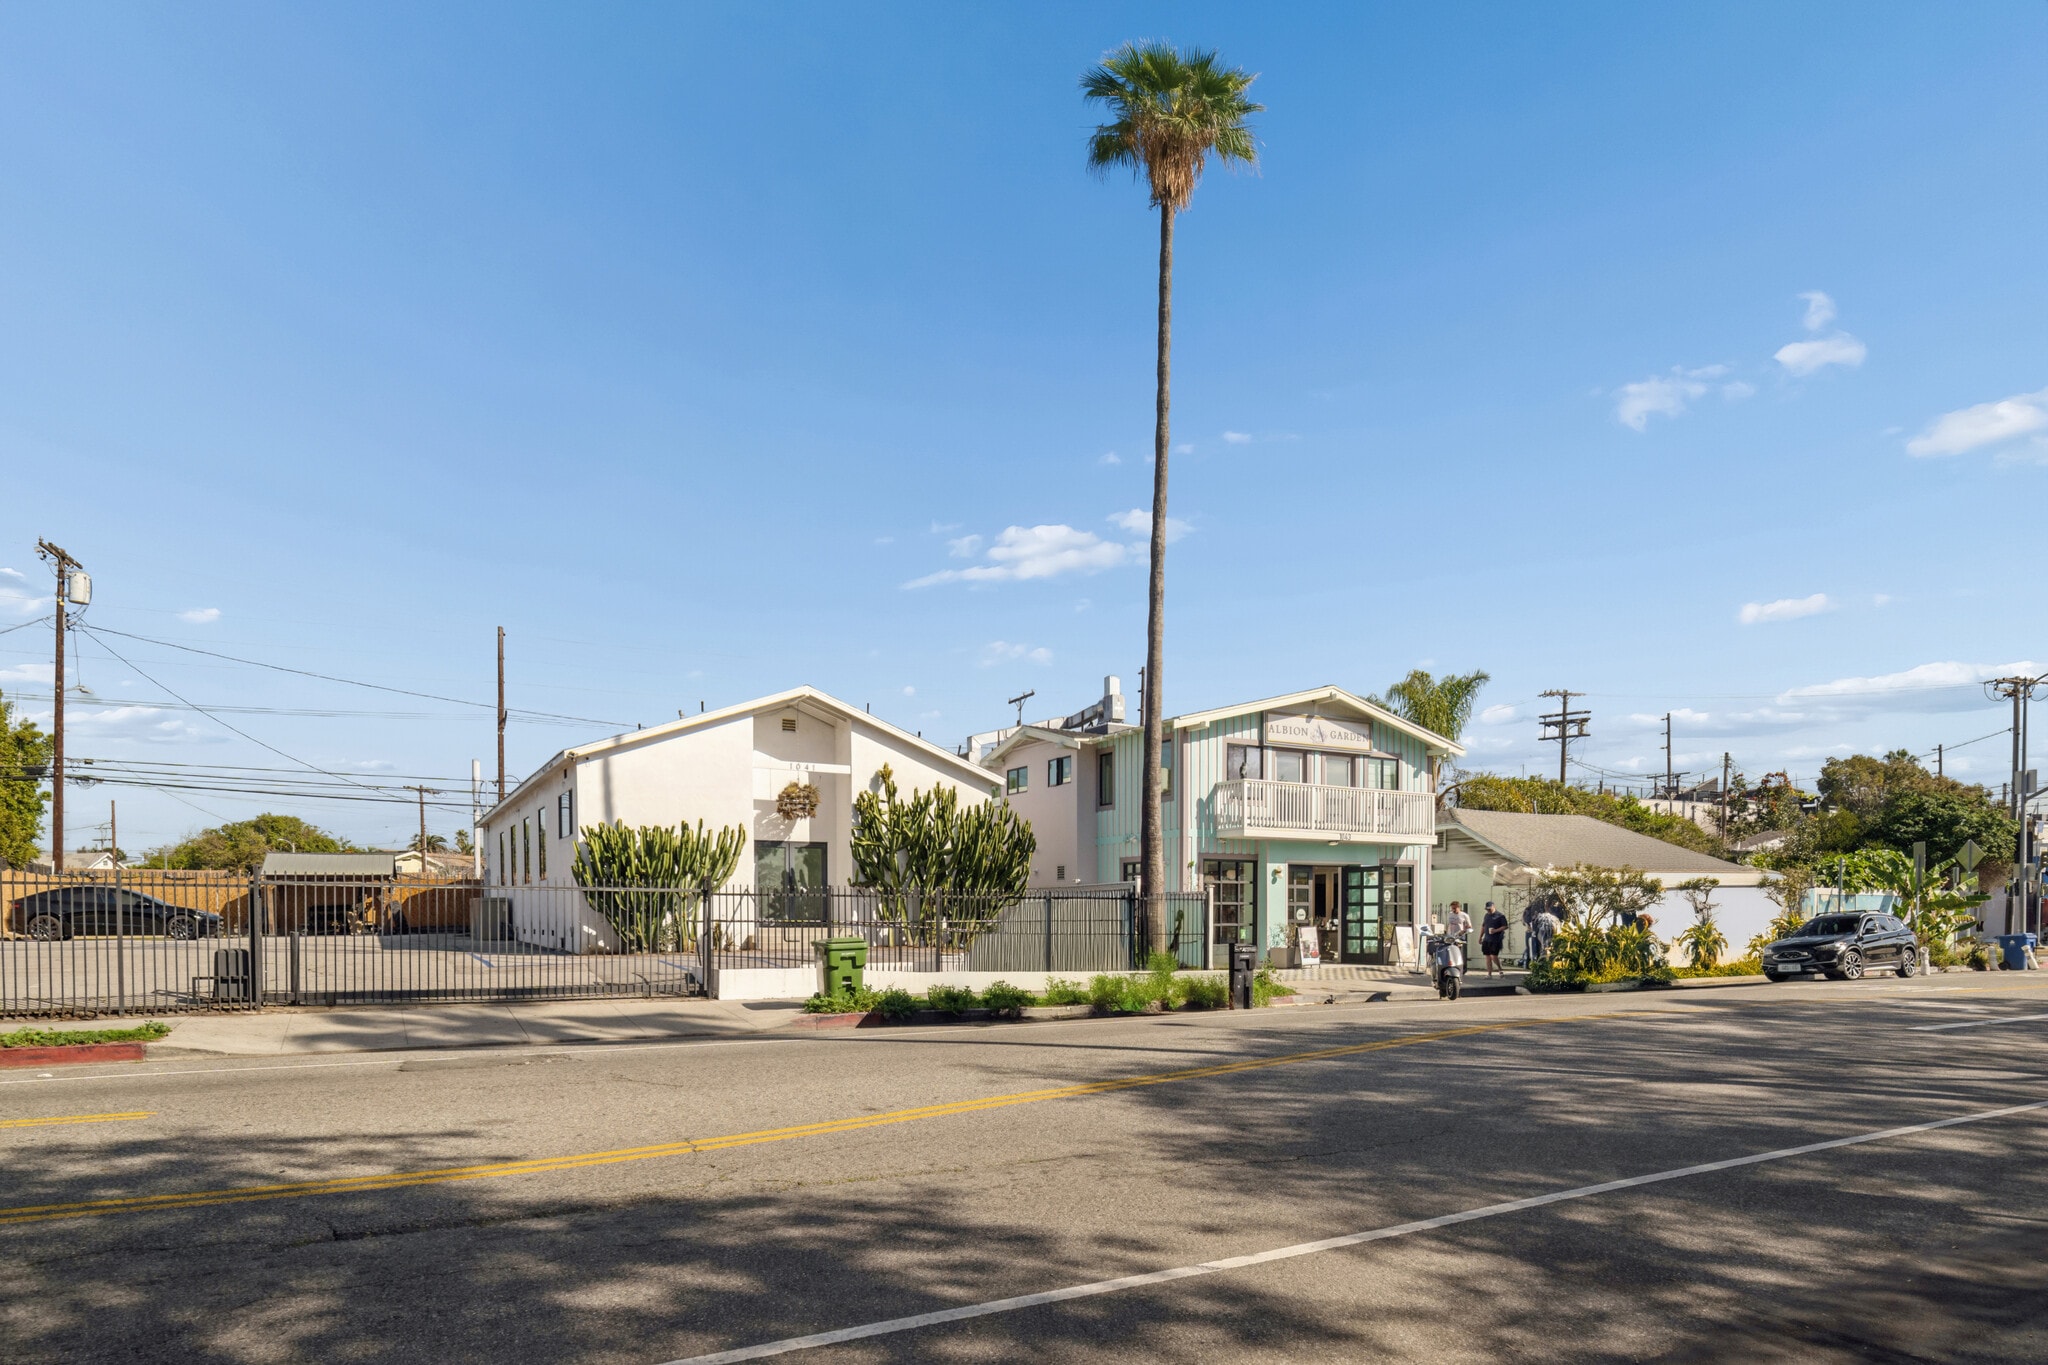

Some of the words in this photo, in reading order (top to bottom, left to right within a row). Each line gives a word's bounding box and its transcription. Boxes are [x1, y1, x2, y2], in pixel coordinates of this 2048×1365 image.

[1269, 724, 1308, 736] ALBION
[1330, 730, 1369, 742] GARDEN
[790, 763, 815, 771] 1041
